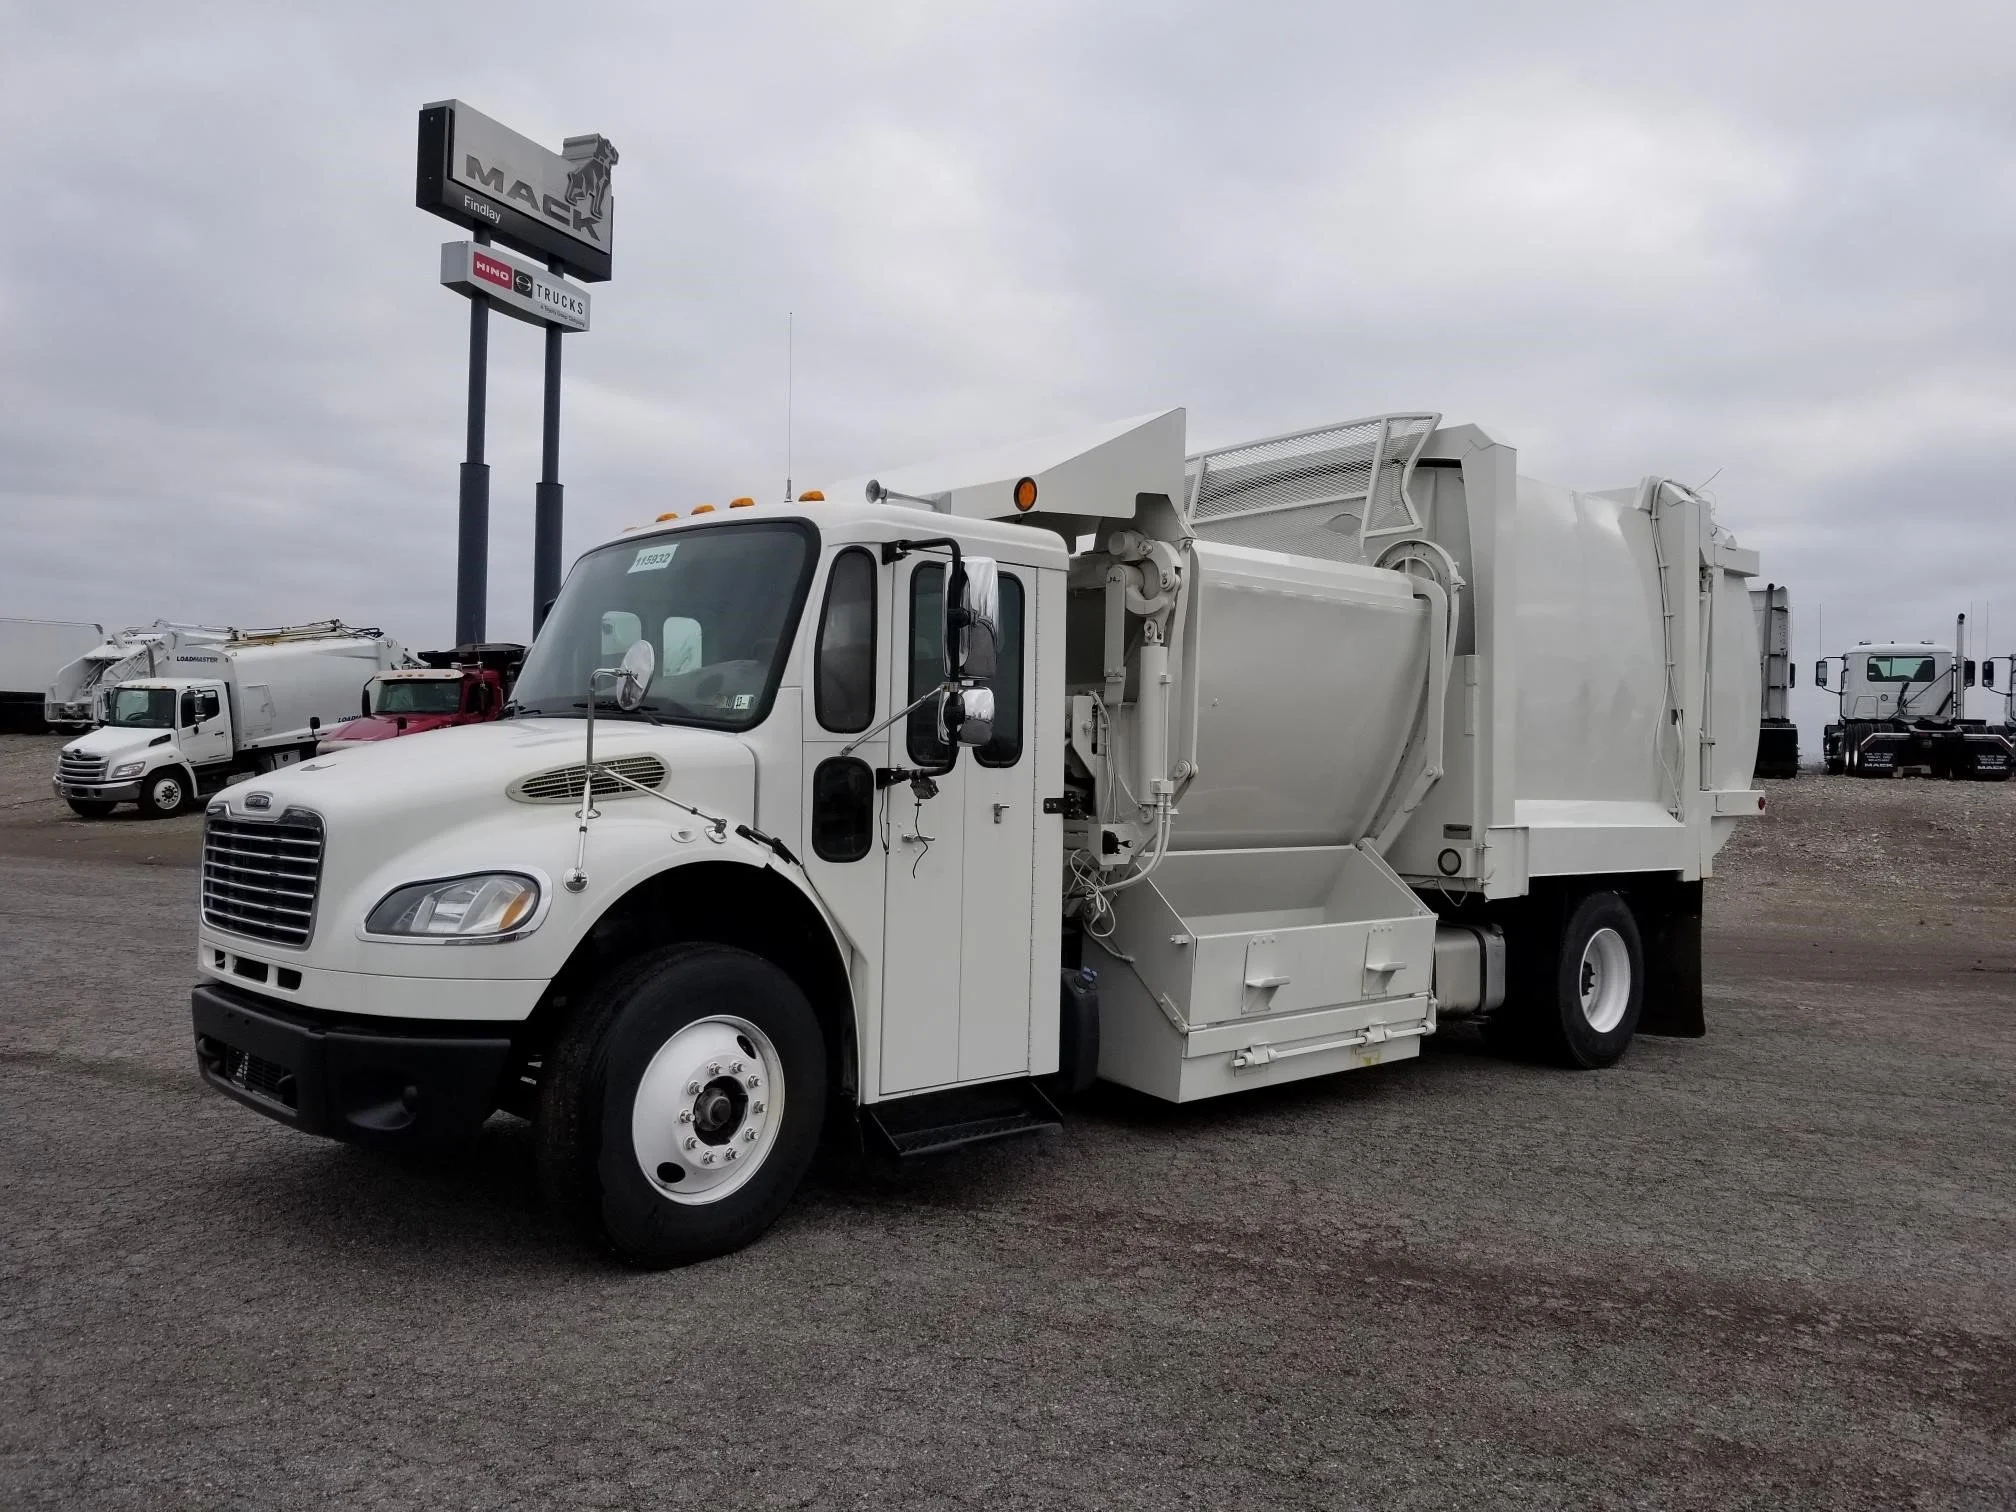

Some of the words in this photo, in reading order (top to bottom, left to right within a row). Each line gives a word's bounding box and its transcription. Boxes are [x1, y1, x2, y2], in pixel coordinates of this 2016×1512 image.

[463, 195, 502, 225] Findlay
[465, 153, 602, 242] MACK
[476, 259, 510, 282] HINO
[537, 283, 584, 315] TRUCKS
[176, 655, 218, 663] LOADMASTER
